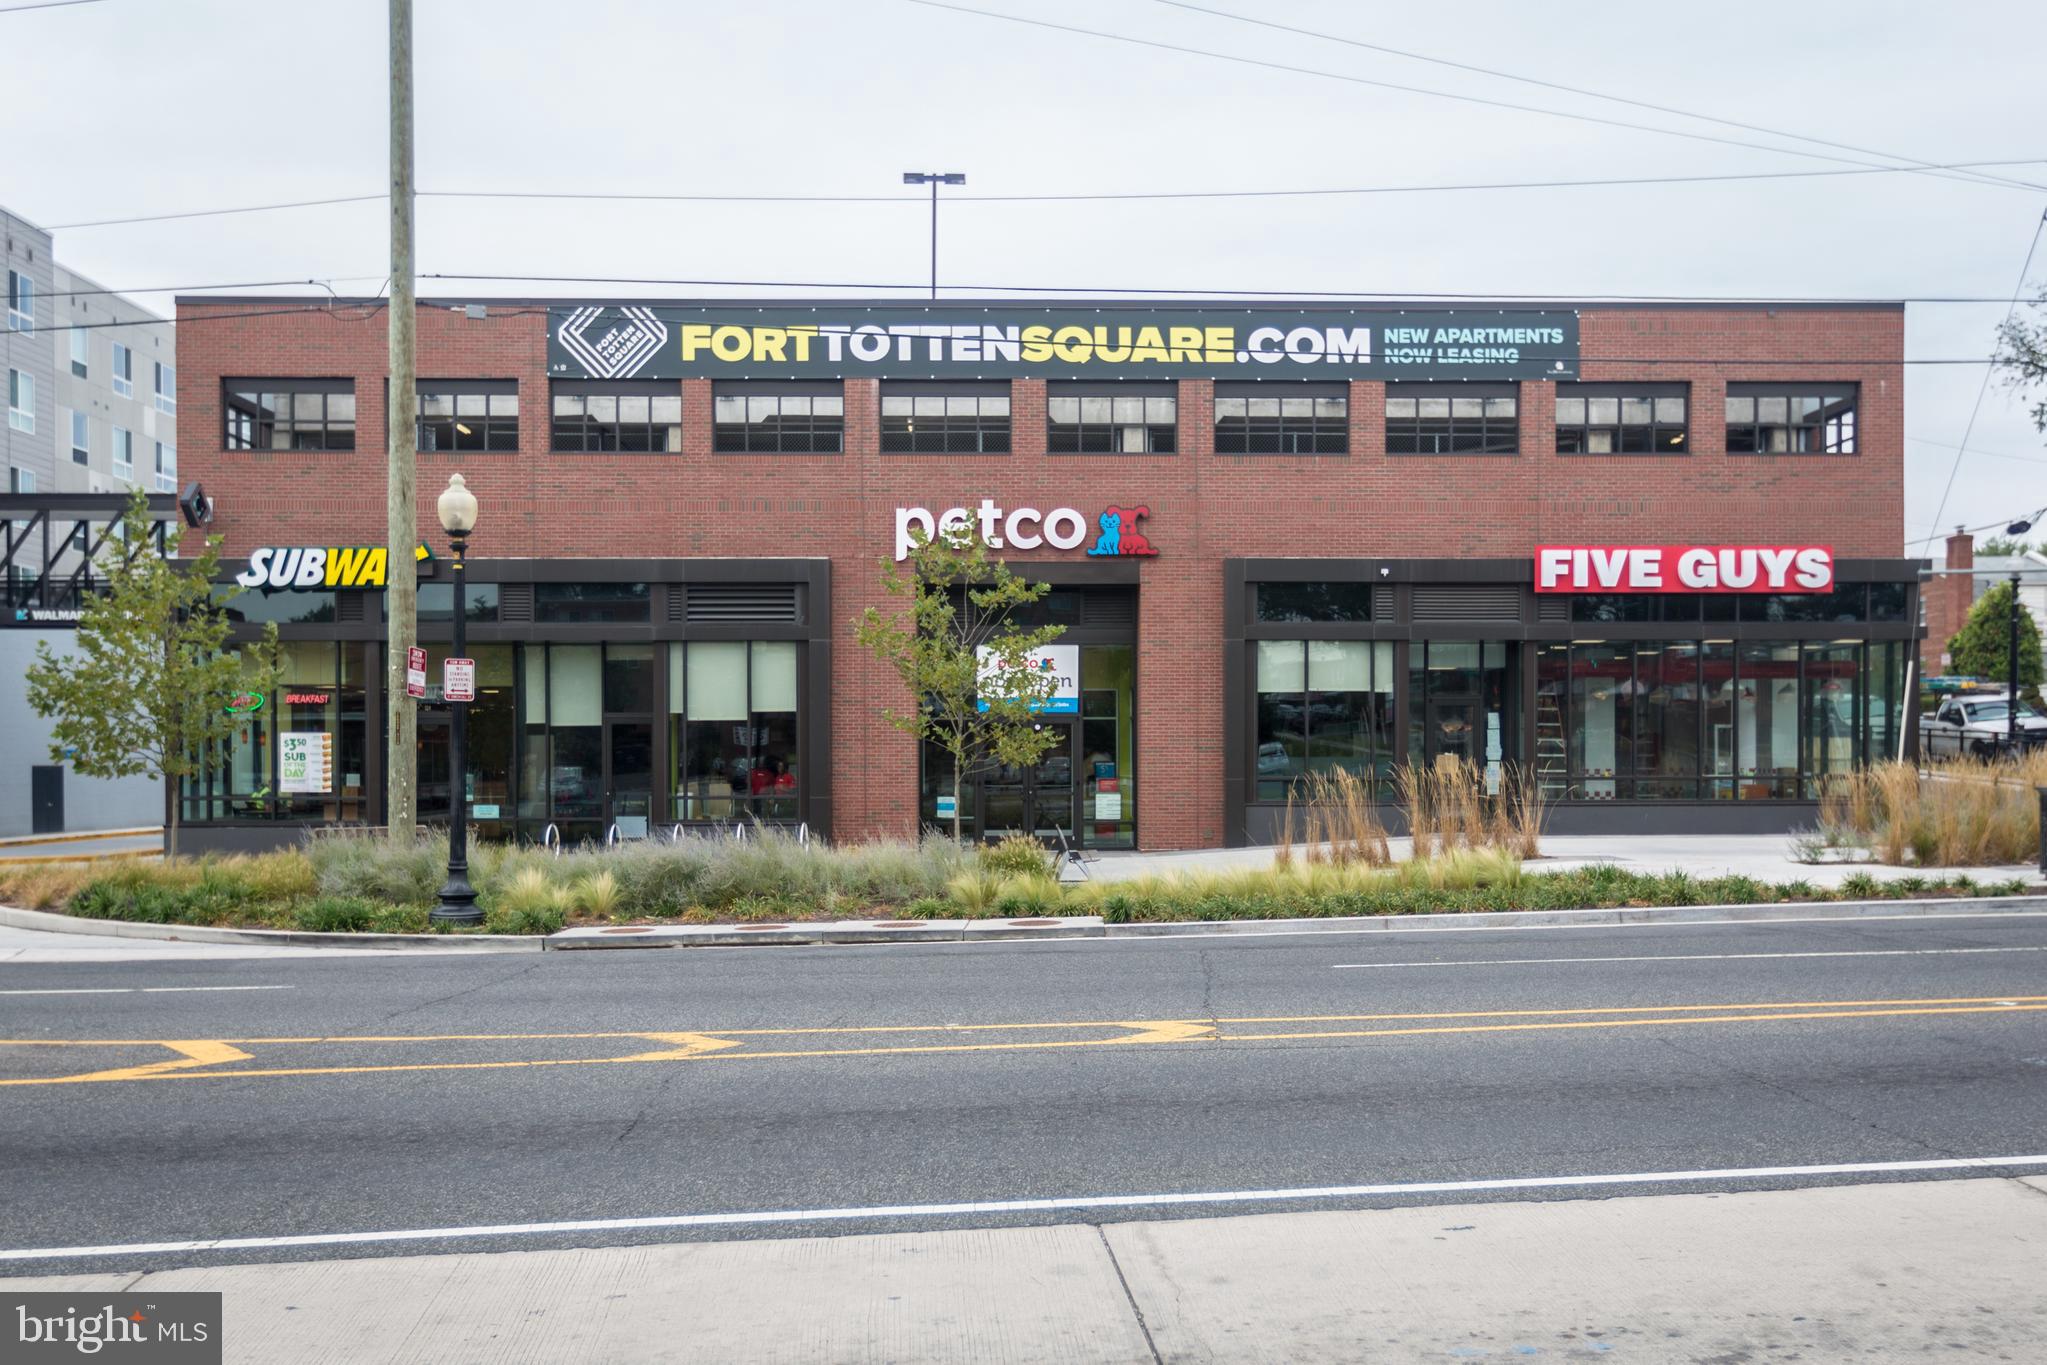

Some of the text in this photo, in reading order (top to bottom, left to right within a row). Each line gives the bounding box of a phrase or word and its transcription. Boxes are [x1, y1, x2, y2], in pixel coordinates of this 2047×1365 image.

[595, 328, 619, 352] FORT
[601, 325, 636, 359] TOTTEN
[609, 329, 645, 366] SQUARE
[682, 325, 1371, 364] FORTTOTTENSQUARE.COM
[1384, 328, 1564, 344] NEW APARTMENTS
[1384, 347, 1519, 364] NOW LEASING
[896, 499, 1087, 562] petco
[236, 545, 430, 588] SUBWA
[1539, 547, 1832, 590] FIVE GUYS
[285, 694, 329, 704] BREAKFAST
[284, 752, 306, 761] SUB
[284, 768, 305, 777] DAY
